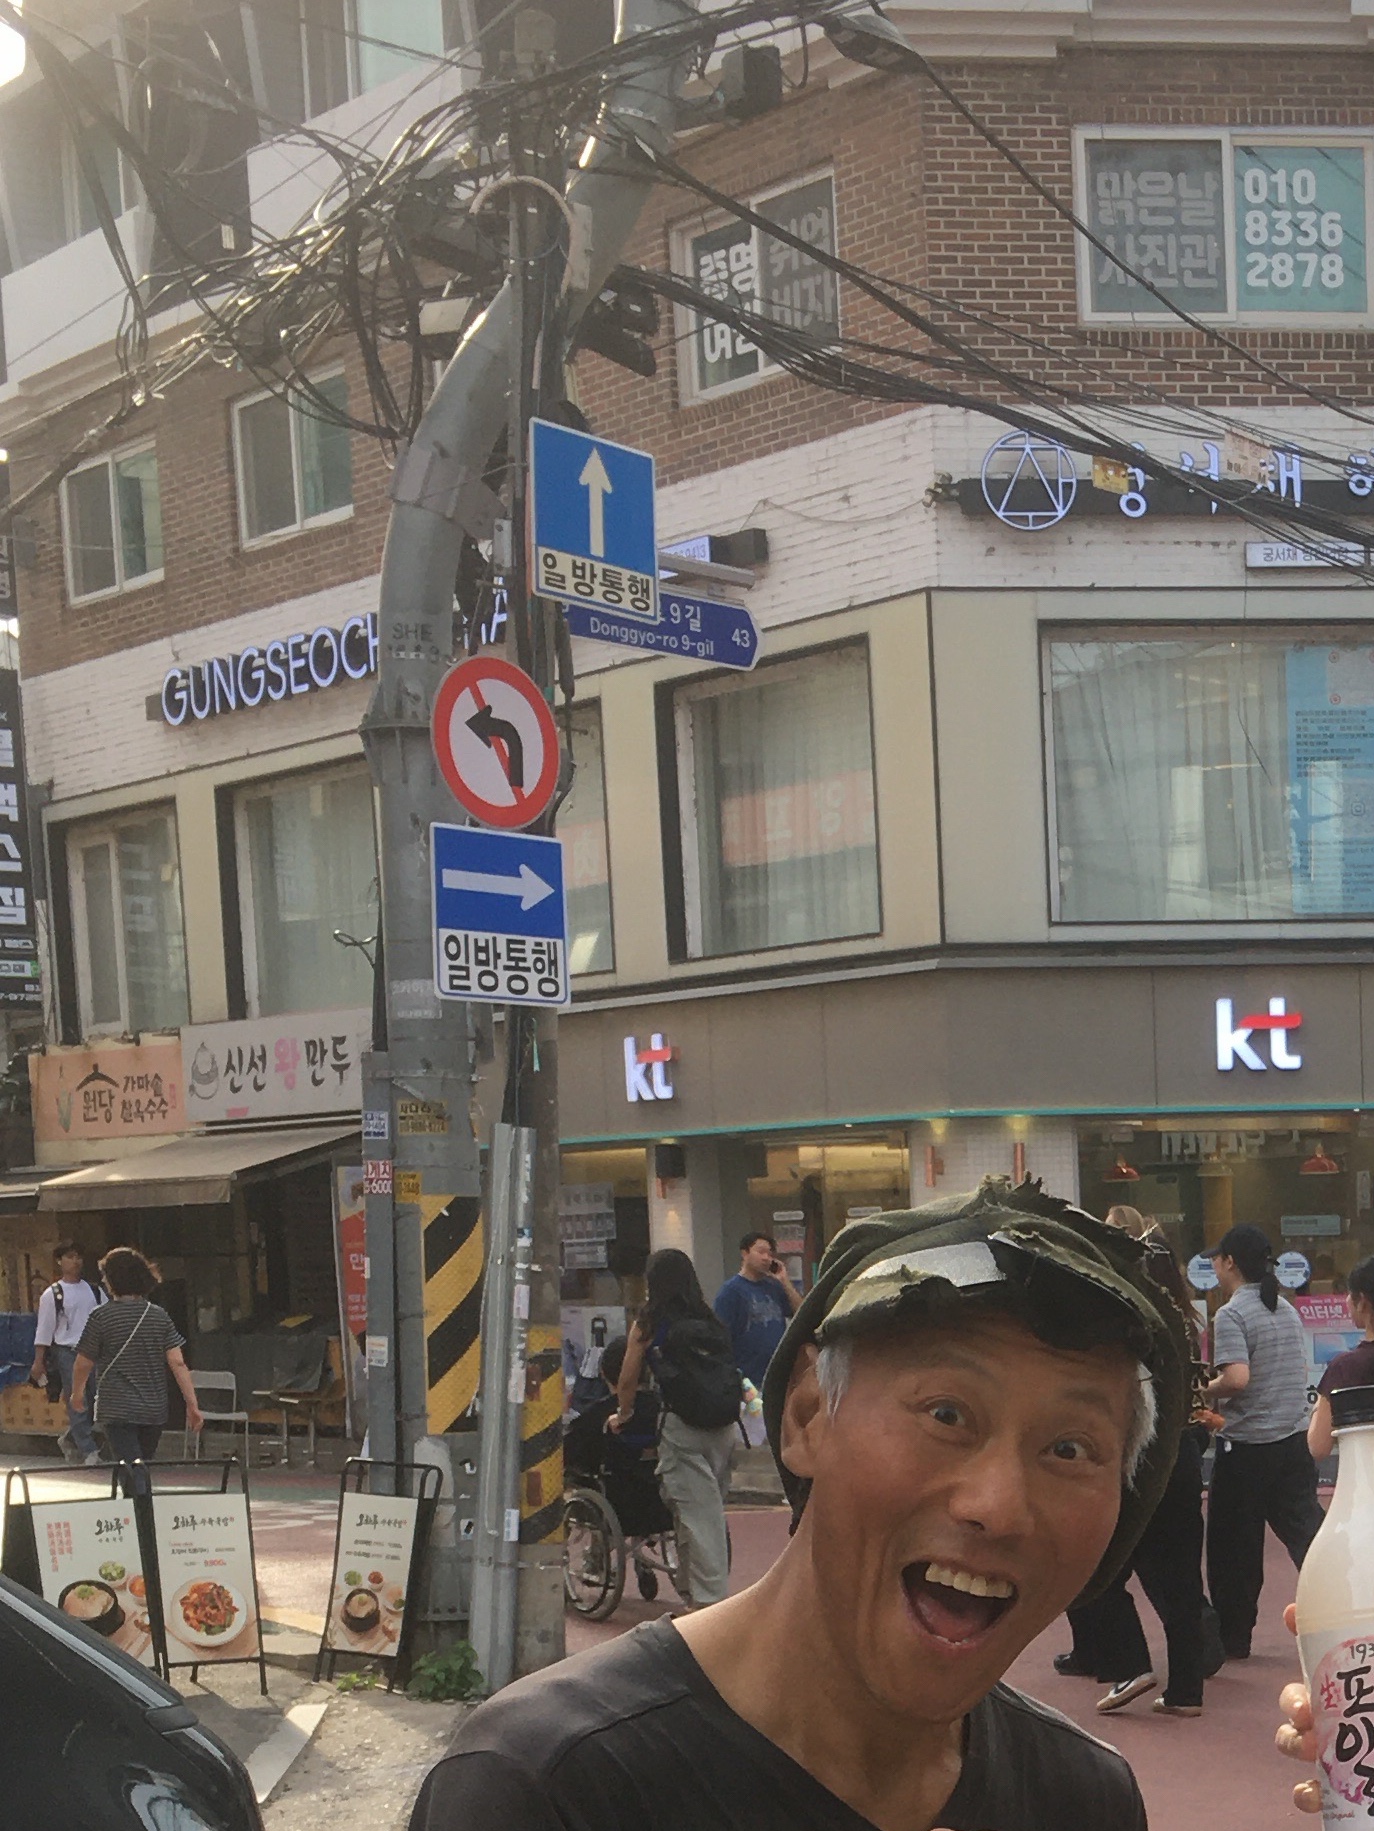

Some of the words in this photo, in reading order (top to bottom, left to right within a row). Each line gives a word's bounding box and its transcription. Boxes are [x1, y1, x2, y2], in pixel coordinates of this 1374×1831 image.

[1097, 170, 1219, 226] 맑은날
[1244, 168, 1316, 204] 010
[1245, 210, 1343, 246] 8336
[1098, 233, 1220, 288] 사진관
[1246, 252, 1344, 288] 2878
[1262, 547, 1299, 563] 궁서채
[542, 552, 650, 612] 일방통행
[590, 616, 679, 649] Donggyo-ro
[681, 635, 715, 657] 9-gil
[732, 629, 751, 648] 43
[443, 934, 560, 999] 일방통행
[1216, 996, 1302, 1072] kt
[615, 1032, 680, 1102] kt
[82, 1089, 116, 1124] 원당
